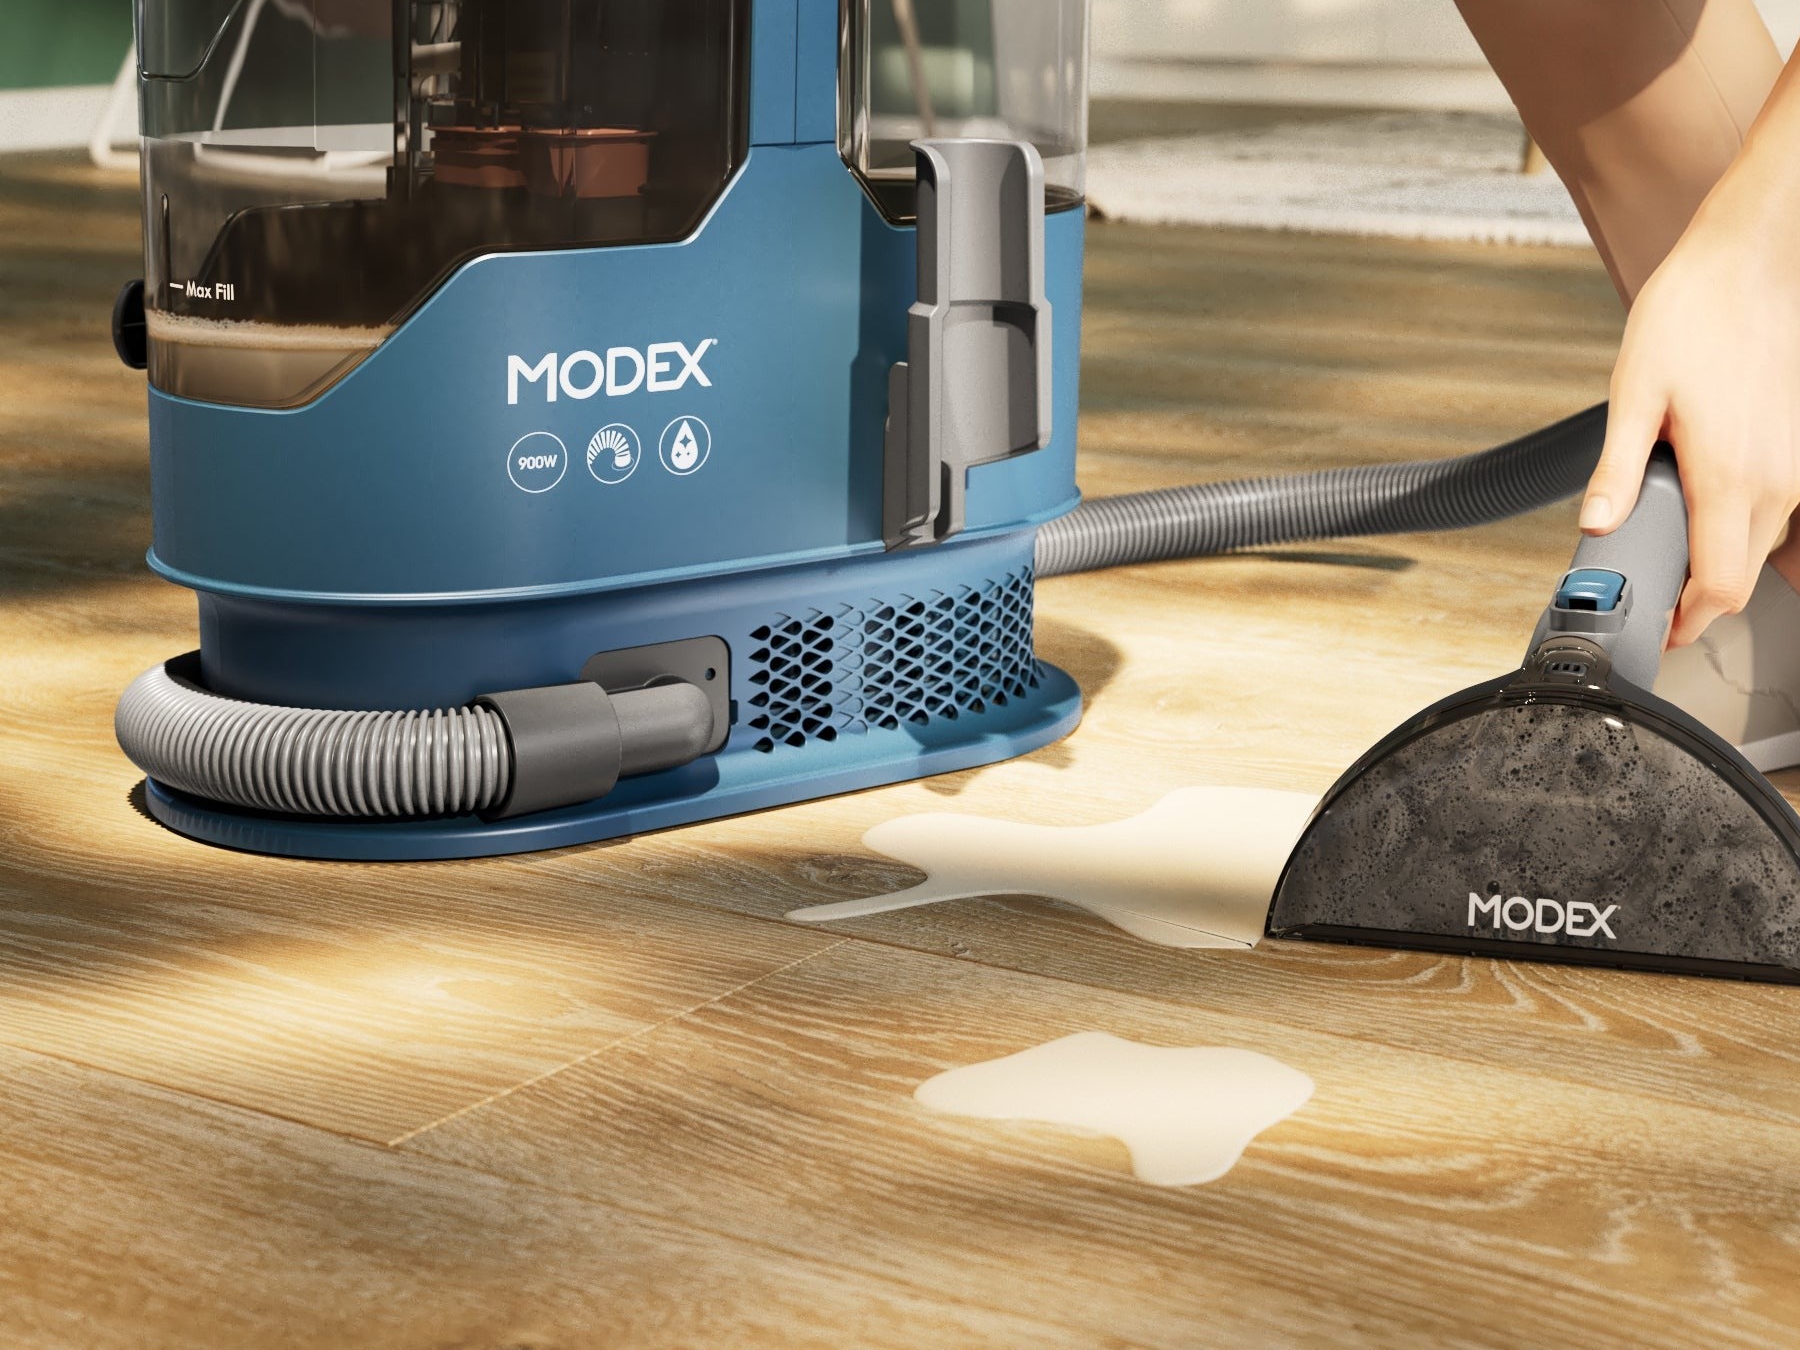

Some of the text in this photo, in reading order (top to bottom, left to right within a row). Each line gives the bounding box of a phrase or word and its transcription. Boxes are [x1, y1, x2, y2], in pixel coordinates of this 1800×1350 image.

[186, 280, 235, 300] Max Fill
[507, 338, 714, 405] MODEX
[518, 454, 558, 470] 900W
[1467, 892, 1618, 940] MODEX
